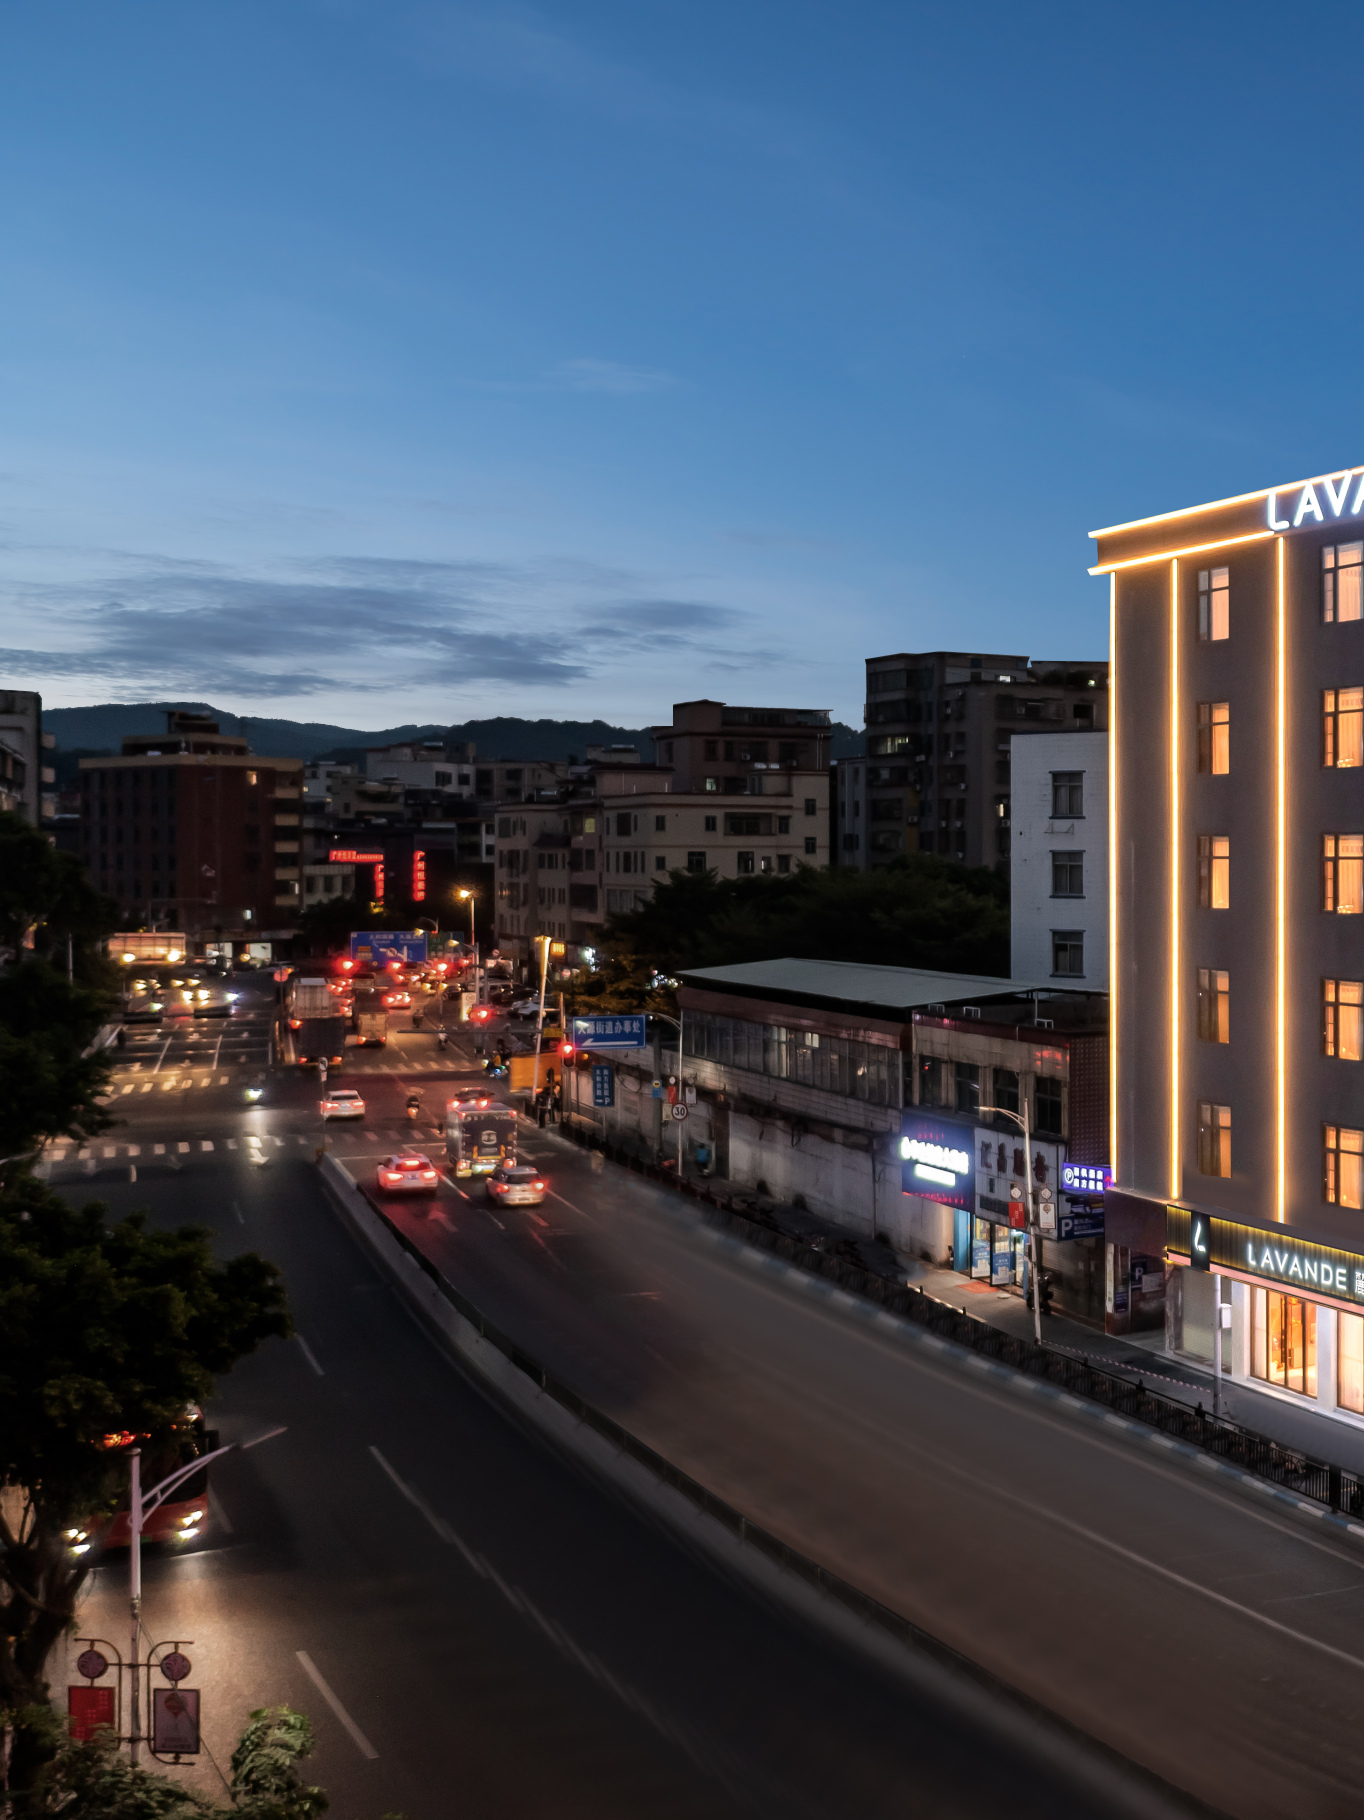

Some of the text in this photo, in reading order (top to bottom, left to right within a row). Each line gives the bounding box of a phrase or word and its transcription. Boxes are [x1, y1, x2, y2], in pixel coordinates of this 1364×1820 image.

[674, 1106, 686, 1117] 30
[1061, 1219, 1073, 1237] P
[1135, 1267, 1144, 1280] P
[1248, 1243, 1347, 1291] LAVANDE
